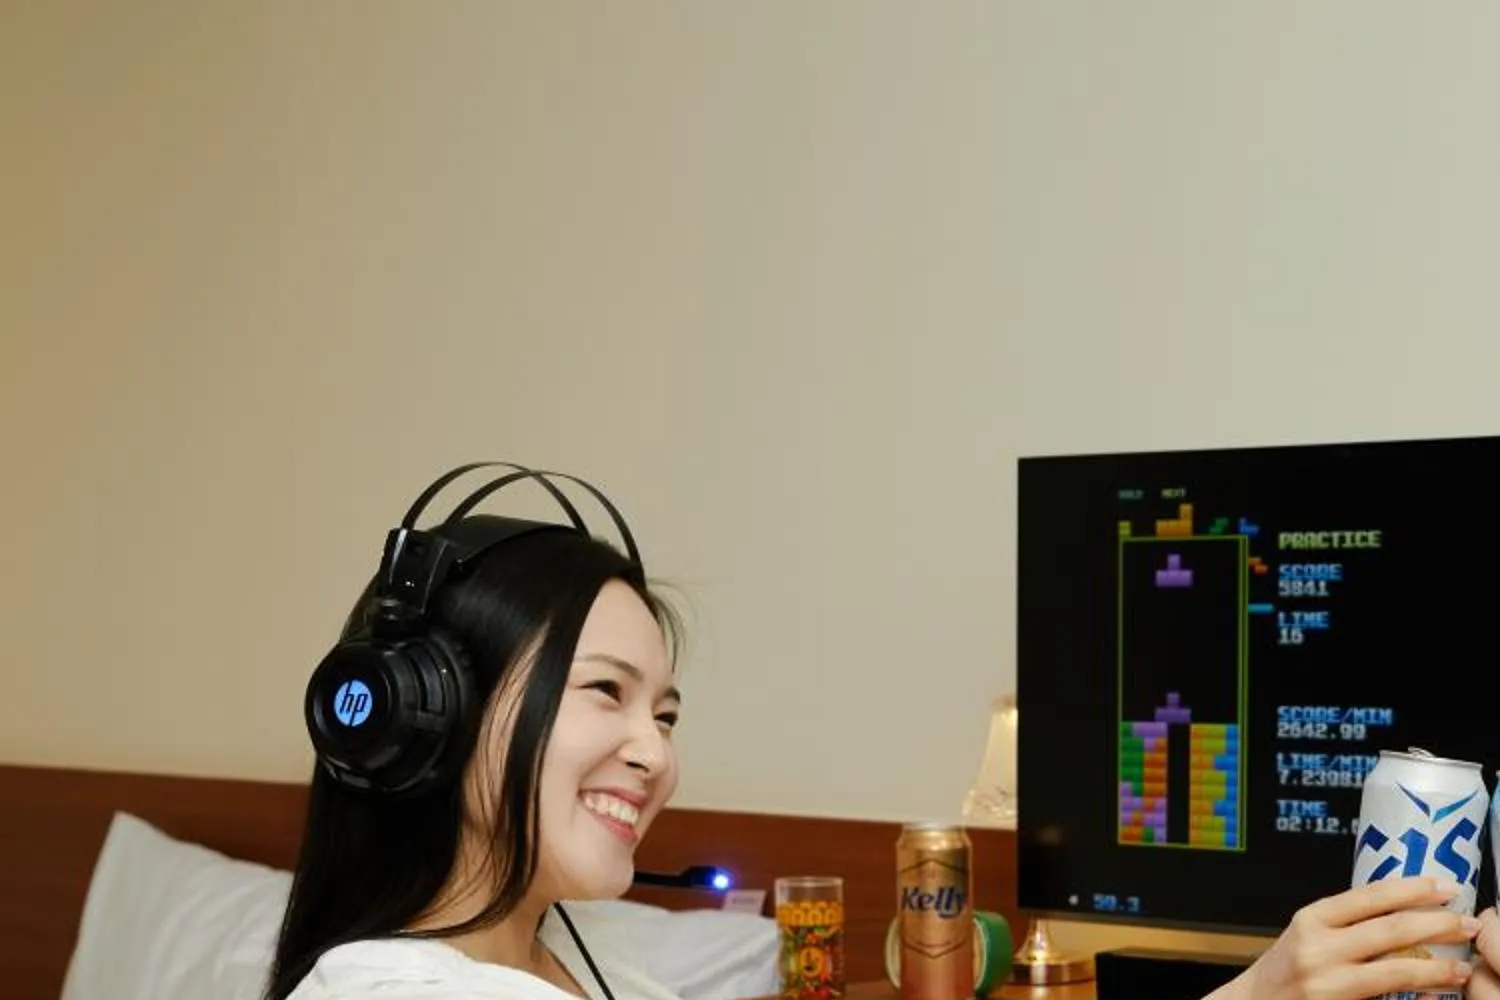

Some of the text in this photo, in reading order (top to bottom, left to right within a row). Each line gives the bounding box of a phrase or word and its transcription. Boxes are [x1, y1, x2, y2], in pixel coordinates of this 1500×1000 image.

[1279, 531, 1382, 550] PRACTICE
[1279, 563, 1343, 581] SCORE
[339, 680, 369, 726] hp
[1277, 800, 1328, 817] TIME
[900, 885, 966, 919] Kelly
